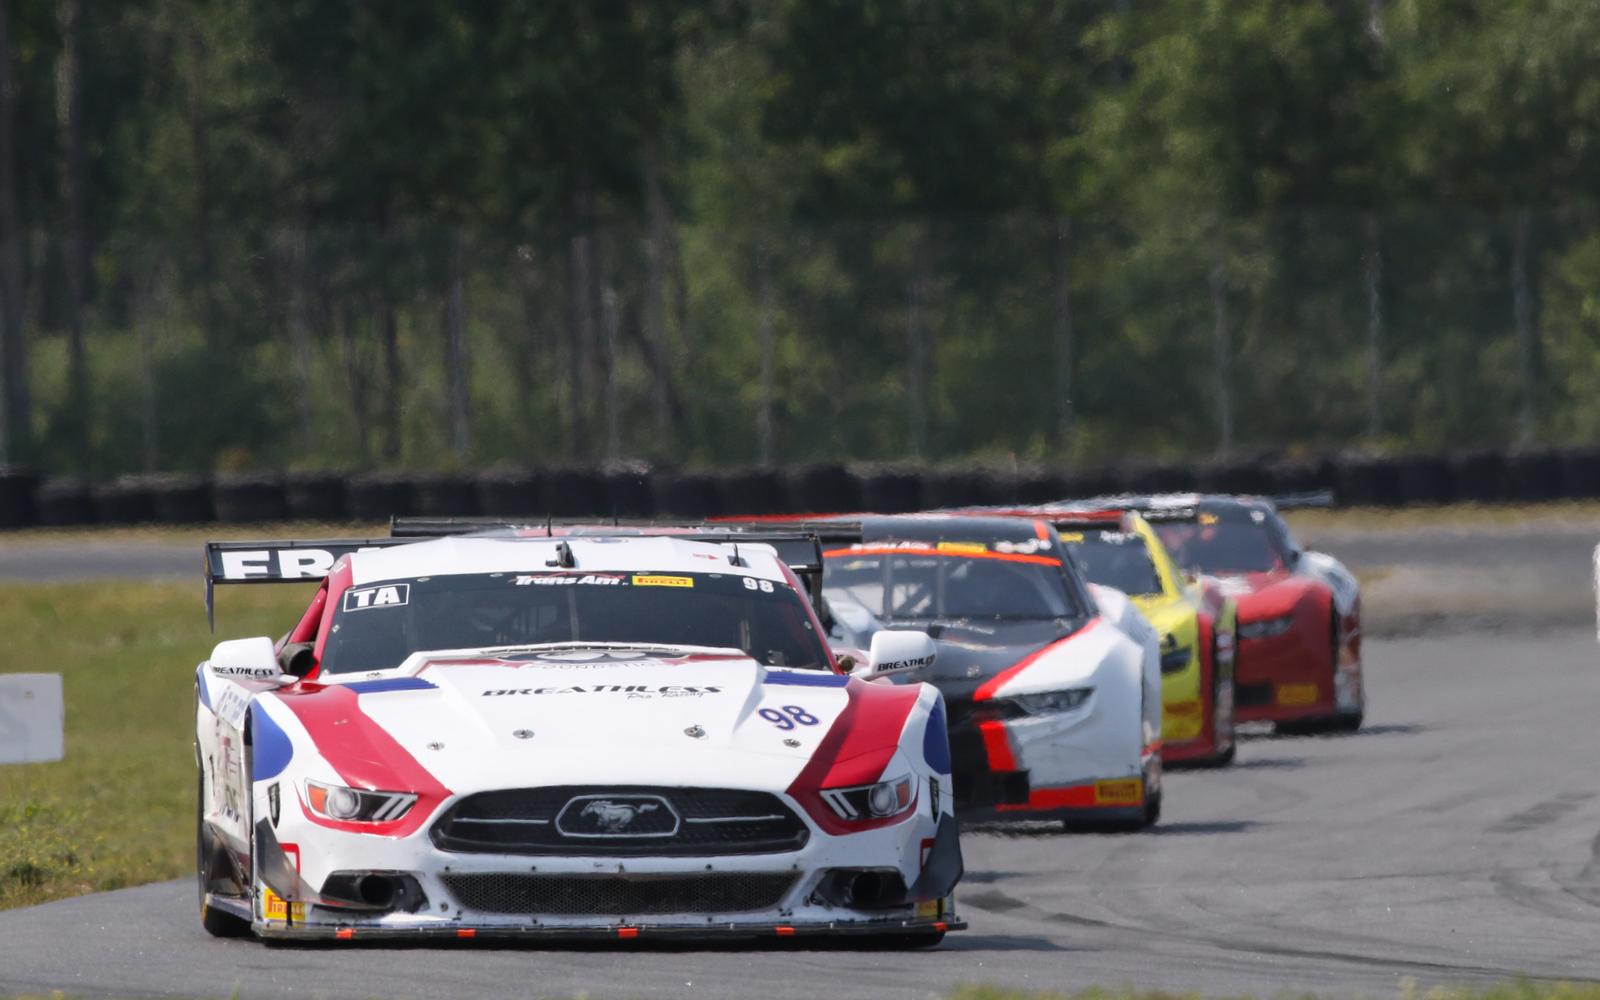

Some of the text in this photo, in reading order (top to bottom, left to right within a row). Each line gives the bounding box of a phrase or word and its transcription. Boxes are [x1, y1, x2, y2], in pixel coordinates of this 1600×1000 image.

[221, 547, 382, 579] FR
[743, 577, 774, 593] 98
[353, 587, 400, 607] TA
[481, 684, 725, 697] BREATHLESS
[758, 705, 819, 731] 98
